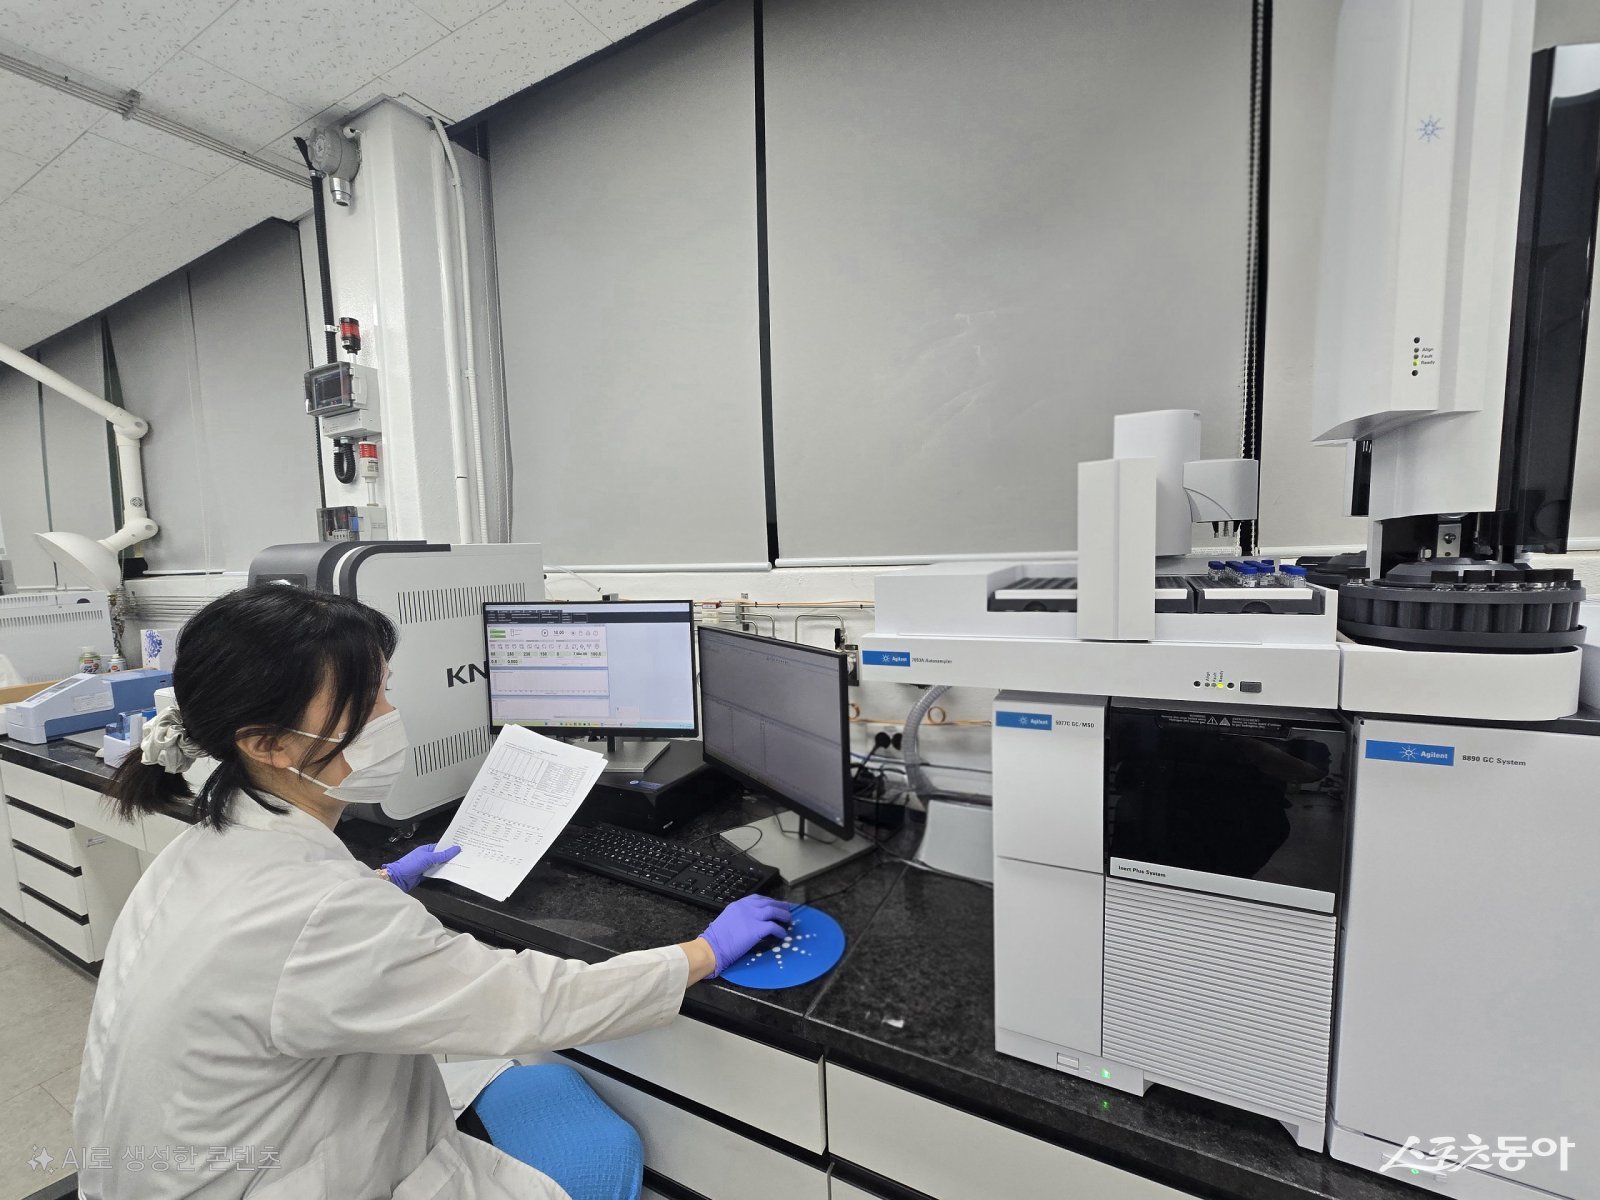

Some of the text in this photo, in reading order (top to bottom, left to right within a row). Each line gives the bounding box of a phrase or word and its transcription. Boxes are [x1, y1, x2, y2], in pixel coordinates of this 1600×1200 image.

[1030, 717, 1048, 726] Agilent
[1420, 749, 1527, 766] Agilent 8890 GC System
[1145, 870, 1166, 878] System
